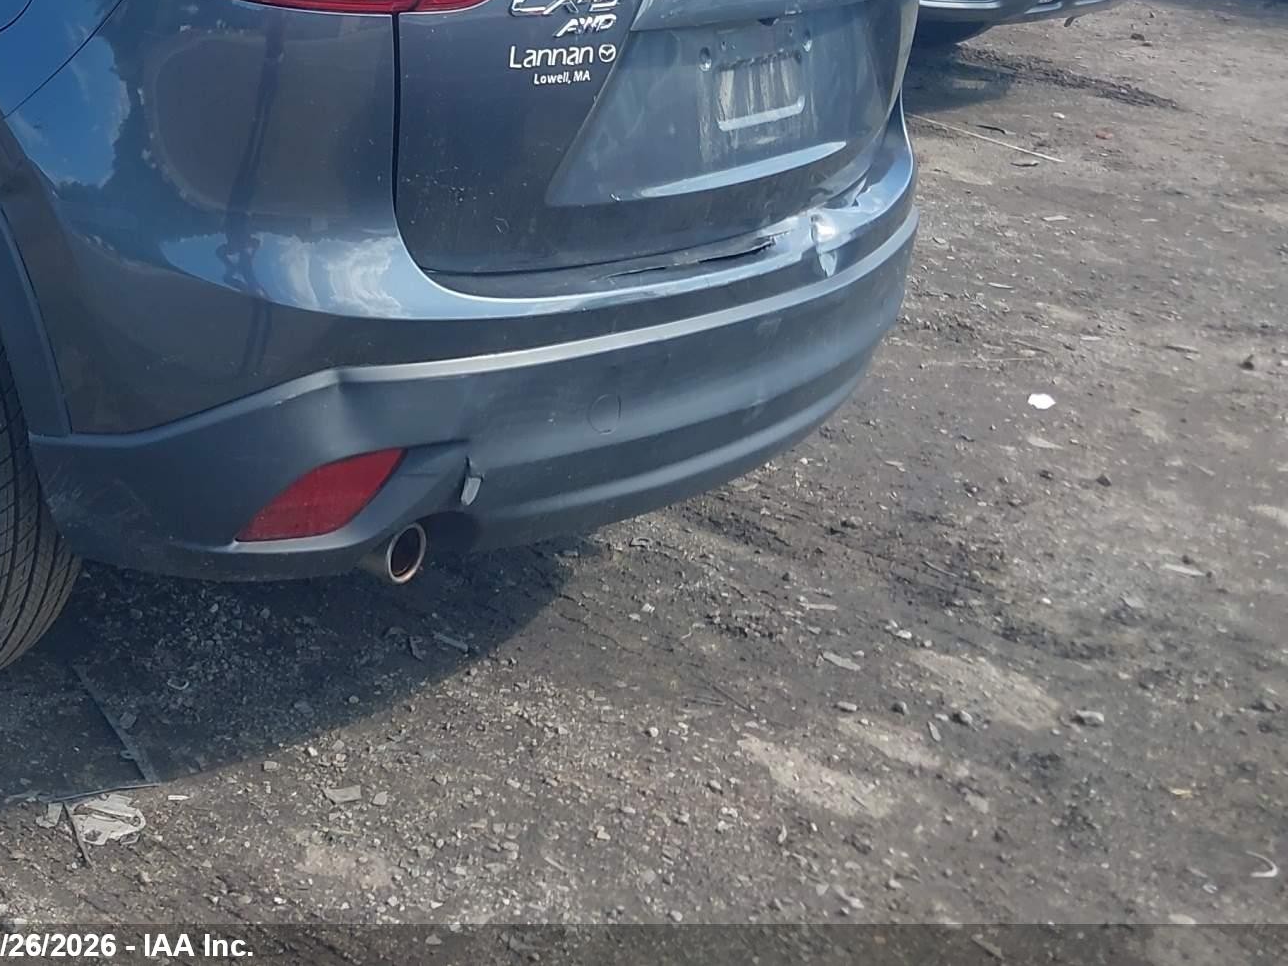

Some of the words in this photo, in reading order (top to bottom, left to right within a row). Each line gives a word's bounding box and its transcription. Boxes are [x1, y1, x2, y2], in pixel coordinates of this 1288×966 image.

[553, 13, 617, 37] AWD
[509, 45, 593, 68] Lannan
[533, 72, 572, 85] Lowell,
[573, 69, 591, 82] MA
